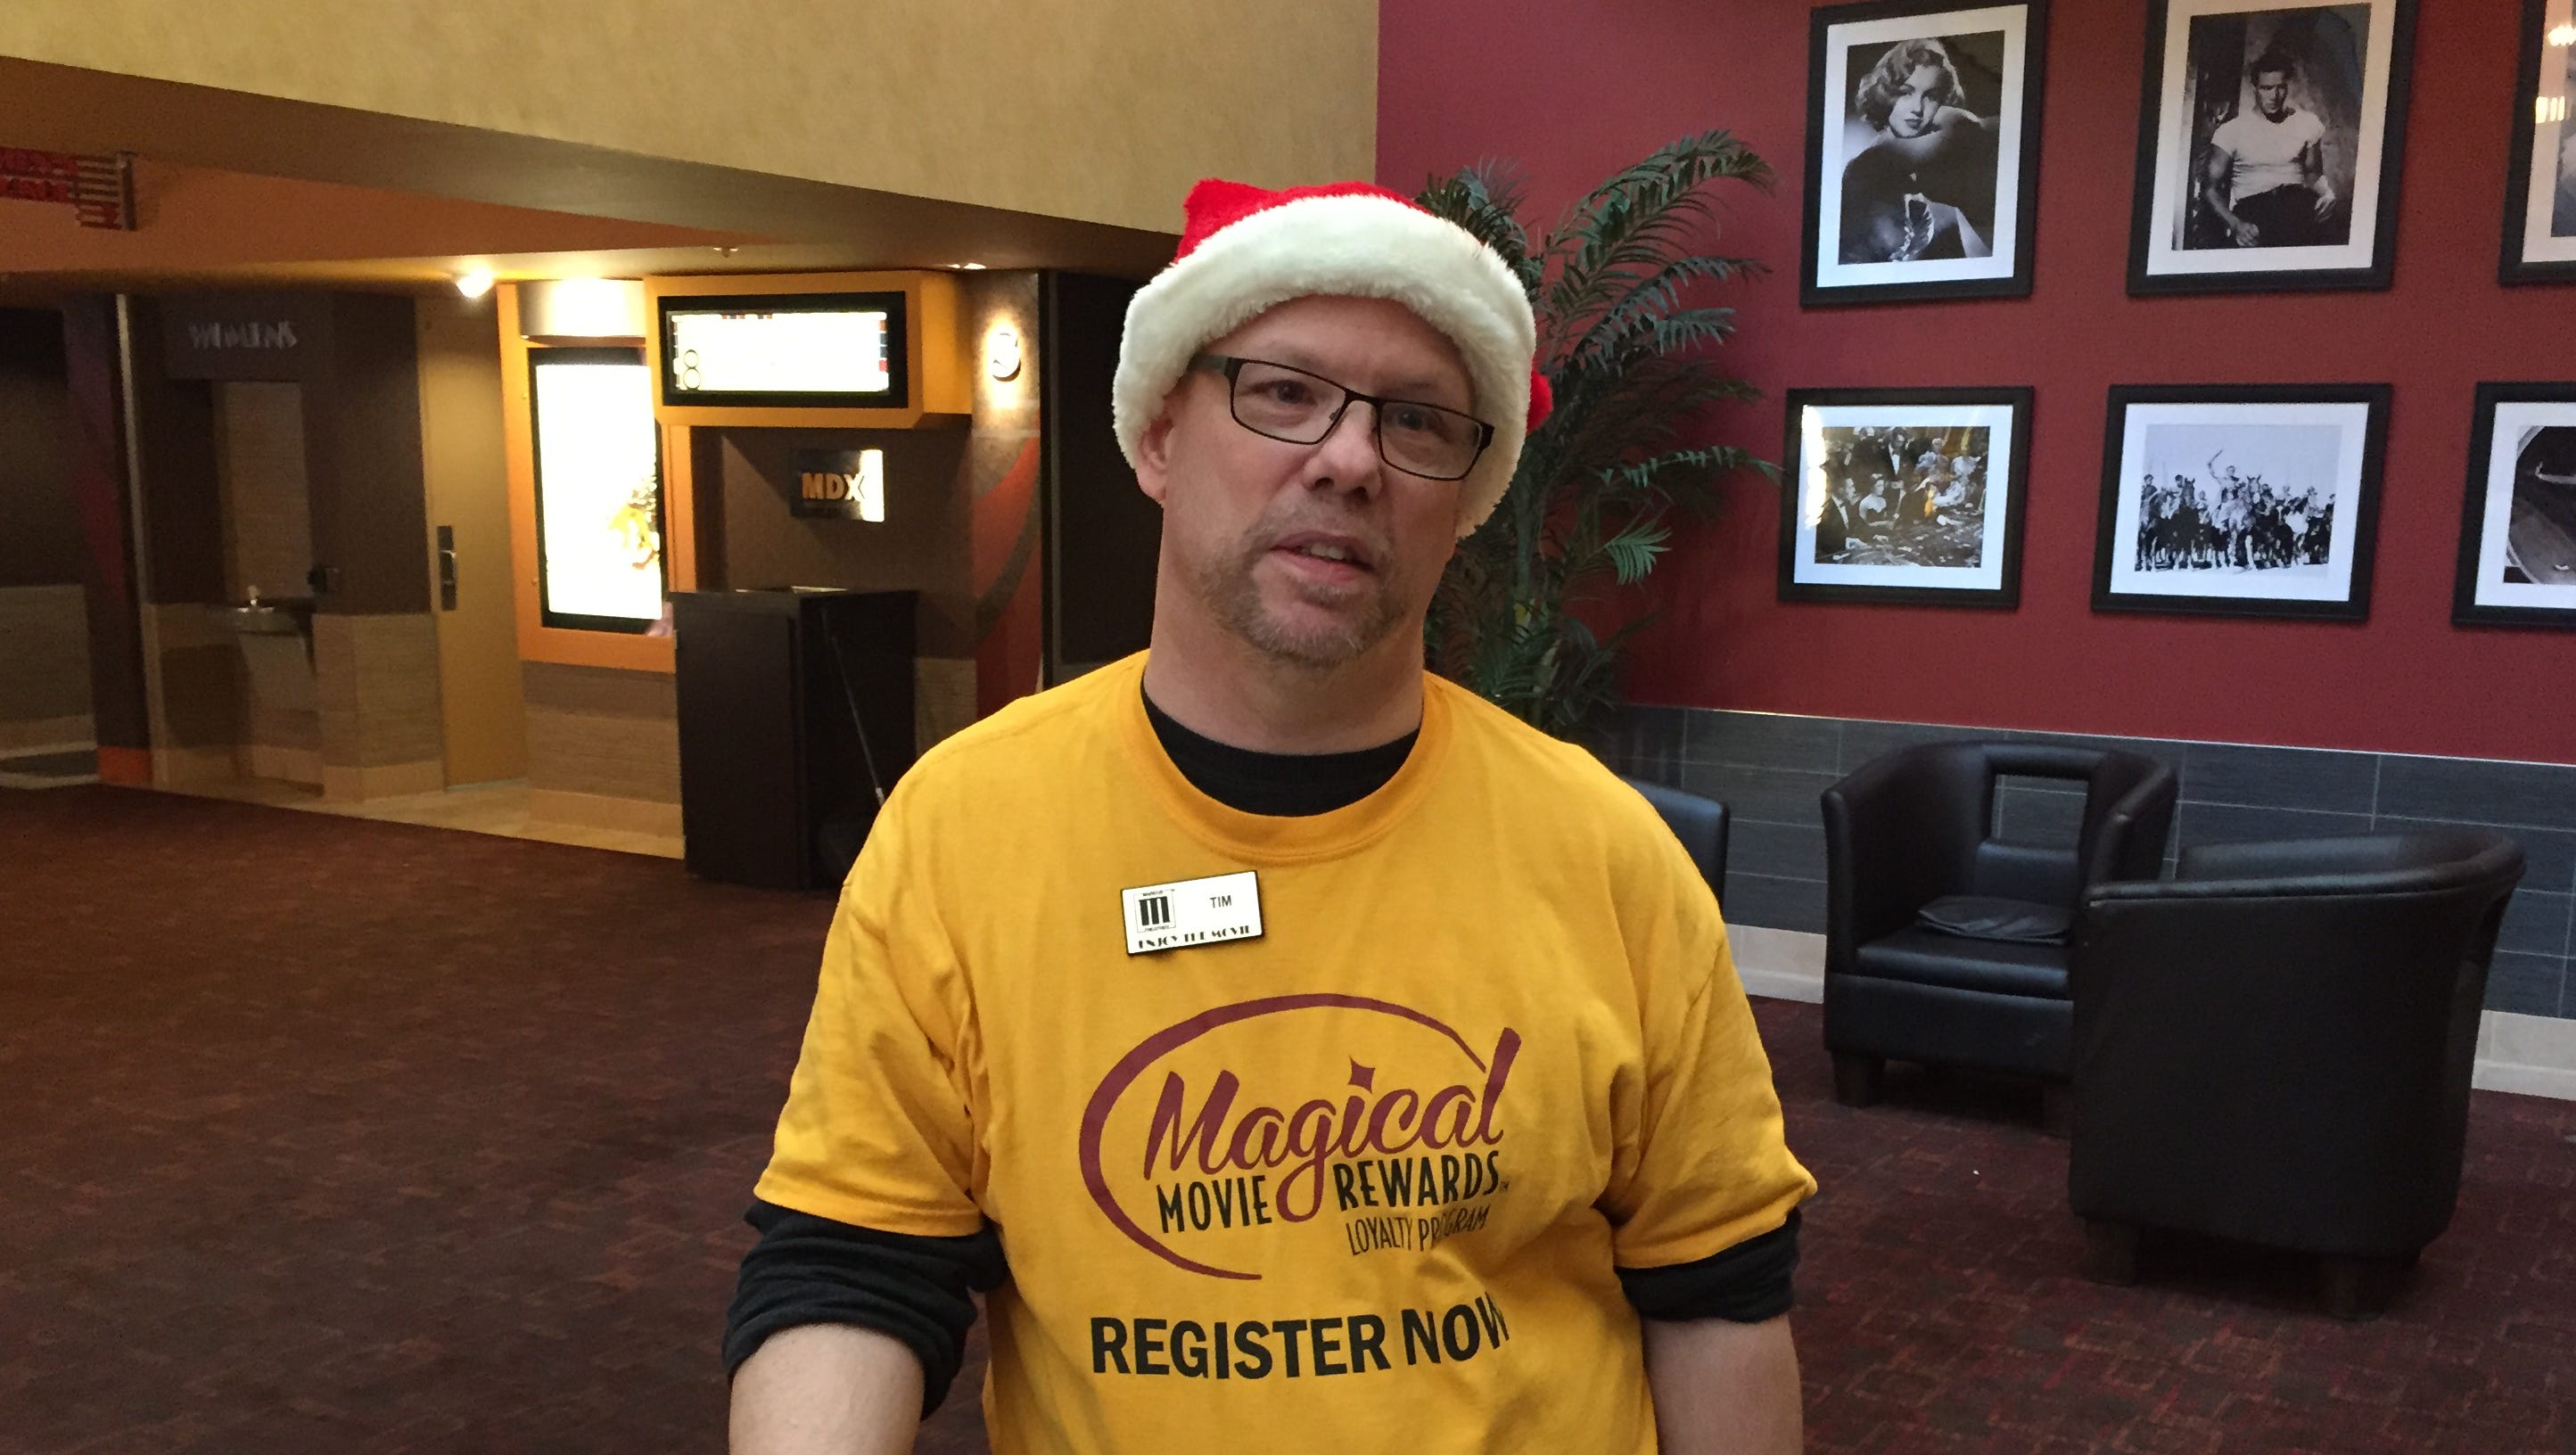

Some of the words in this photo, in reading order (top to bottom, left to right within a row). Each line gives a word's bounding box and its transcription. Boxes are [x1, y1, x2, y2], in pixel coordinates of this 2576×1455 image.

[802, 473, 865, 500] MDX
[1210, 895, 1231, 908] TIM
[1144, 1027, 1521, 1222] Magical
[1156, 1174, 1272, 1233] MOVIE
[1333, 1150, 1500, 1212] REWARDS
[1346, 1217, 1412, 1255] LOYALTY
[1090, 1314, 1391, 1379] REGISTER
[1401, 1292, 1510, 1365] NOW
